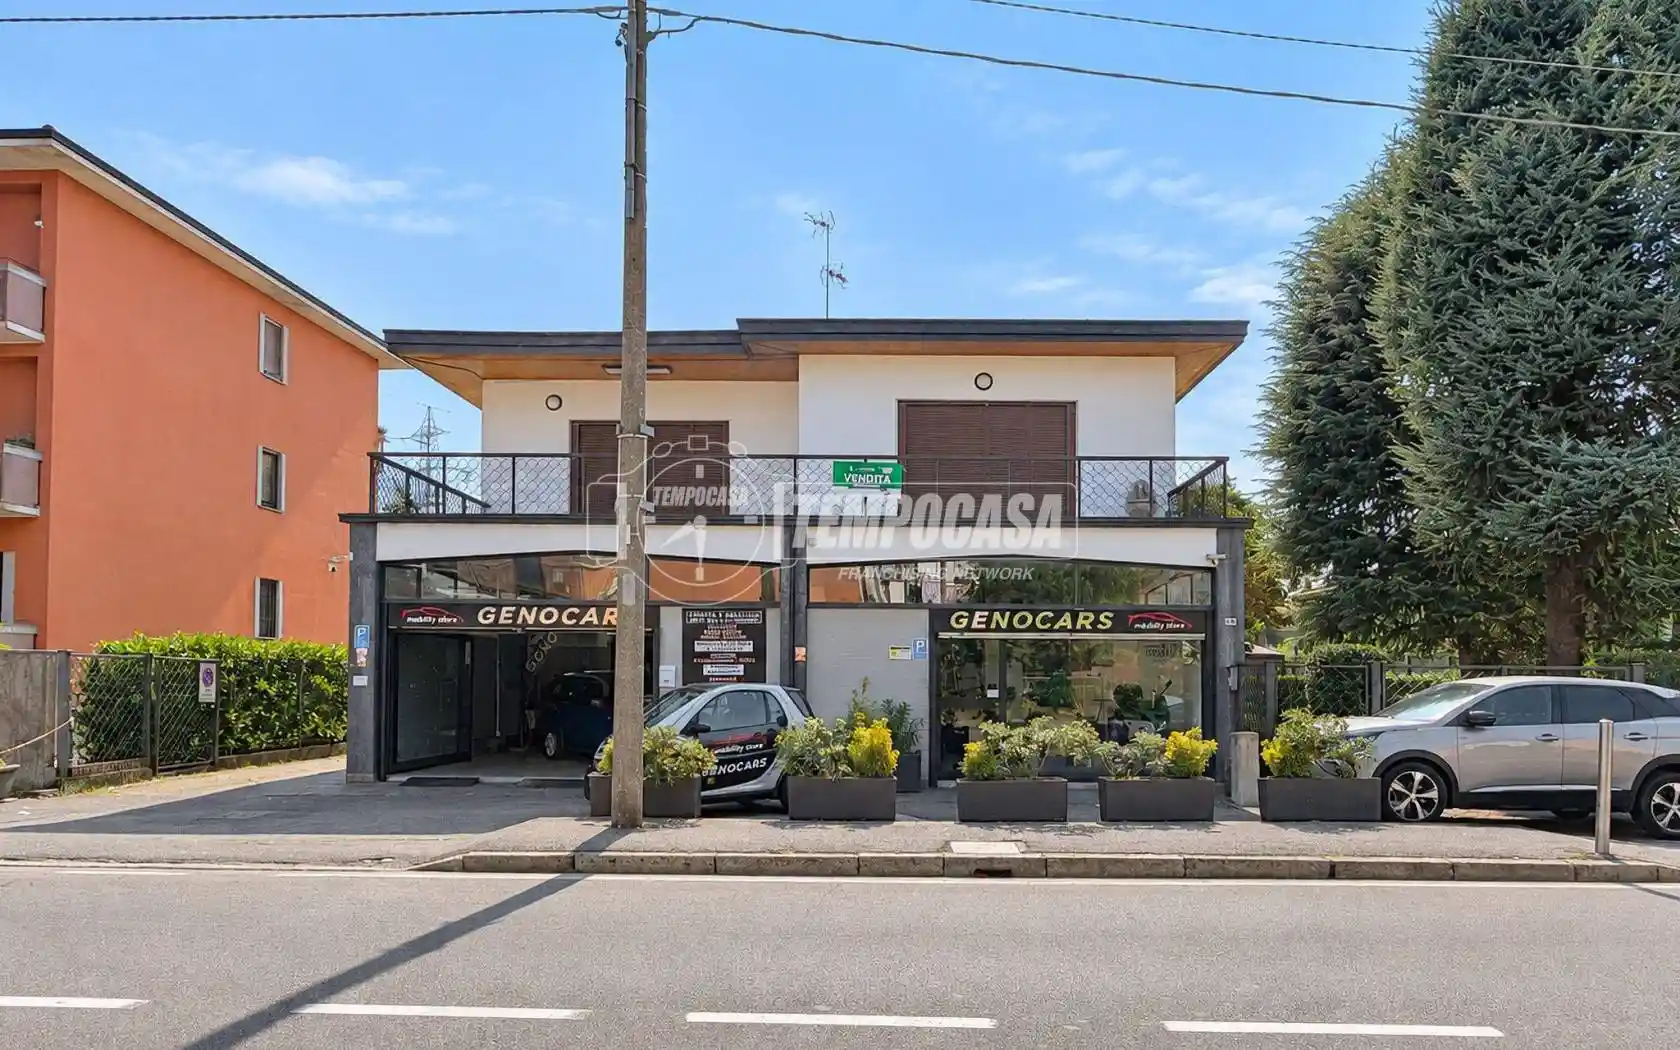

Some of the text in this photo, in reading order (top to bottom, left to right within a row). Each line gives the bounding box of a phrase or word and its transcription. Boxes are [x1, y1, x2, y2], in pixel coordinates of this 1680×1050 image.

[844, 473, 891, 484] VENDITA
[477, 606, 617, 626] GENOCAR
[950, 611, 1115, 630] GENOCARS
